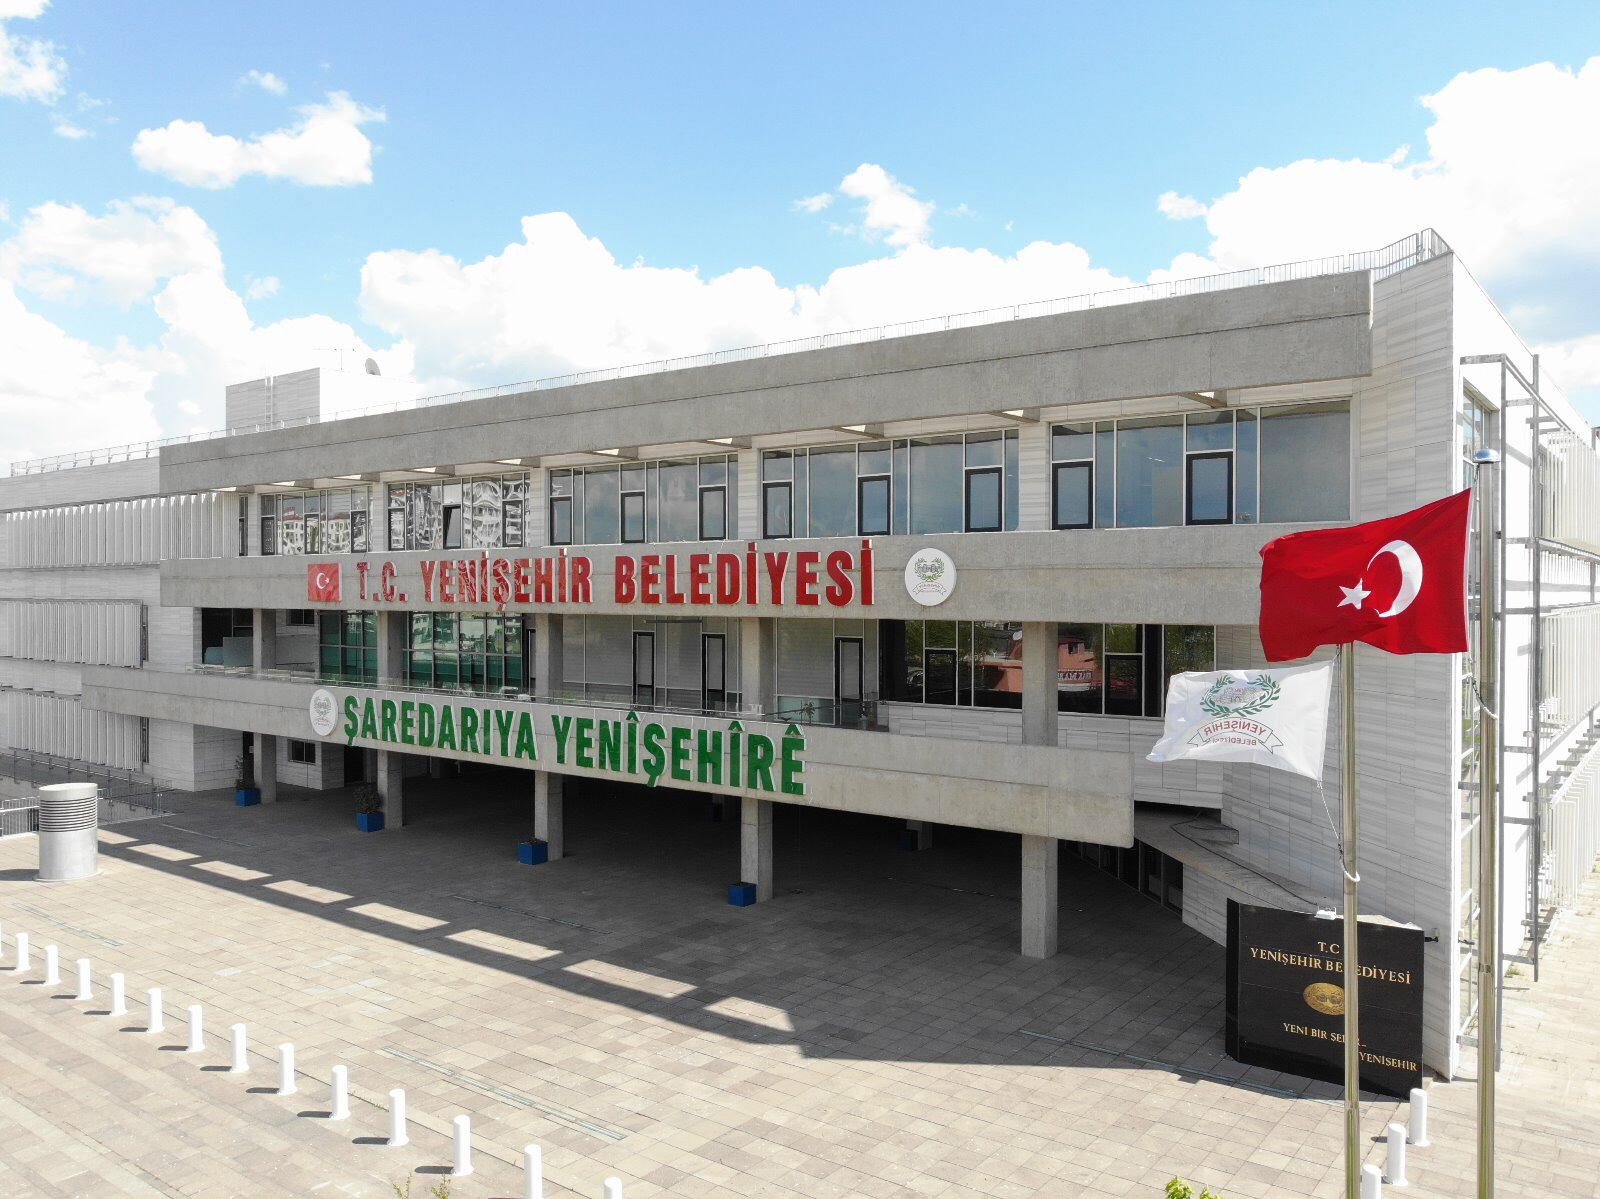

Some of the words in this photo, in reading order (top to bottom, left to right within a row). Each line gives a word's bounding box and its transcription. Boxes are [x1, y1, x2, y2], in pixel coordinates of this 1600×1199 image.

[356, 561, 408, 602] T.C.
[420, 549, 594, 611] YENİŞEHİR
[614, 539, 875, 607] BELEDİYESİ
[344, 695, 539, 761] ŞAREDARIYA
[550, 710, 807, 796] YENÎŞEHÎRÊ
[1250, 947, 1323, 969] YENİŞEHİR
[1325, 960, 1411, 985] BEEDİYESİ
